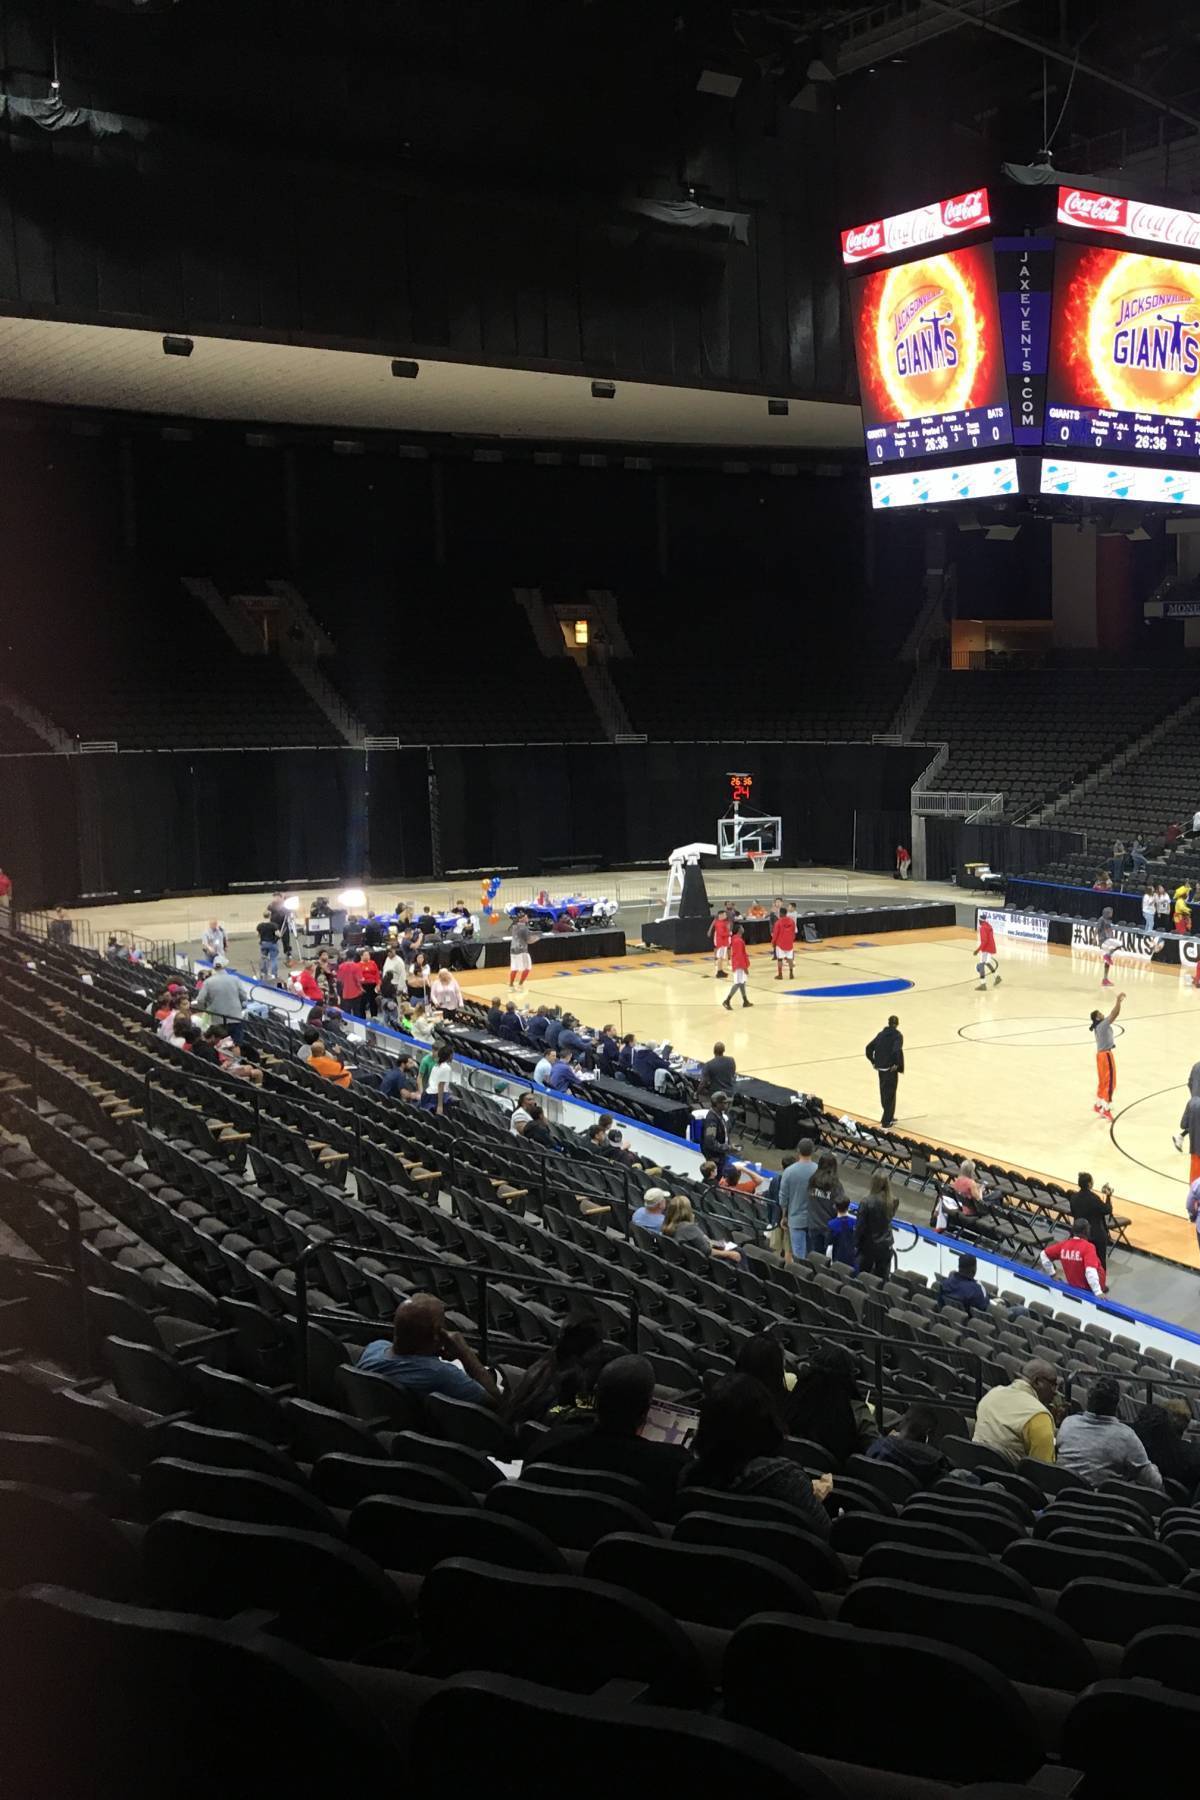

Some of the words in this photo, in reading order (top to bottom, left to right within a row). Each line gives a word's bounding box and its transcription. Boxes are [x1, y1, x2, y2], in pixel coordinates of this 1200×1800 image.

[1065, 191, 1122, 223] Coca-Cola
[895, 326, 958, 377] GIANTS
[1113, 327, 1200, 375] GIANTS
[987, 408, 1003, 419] BATS
[1049, 408, 1080, 420] GIANTS
[922, 427, 940, 437] Period
[992, 427, 999, 441] 0
[1061, 427, 1069, 440] 0
[1134, 423, 1159, 434] Period
[1095, 436, 1102, 447] 0
[1117, 431, 1122, 440] 3
[1134, 434, 1167, 450] 26:36
[1176, 438, 1182, 447] 3
[876, 445, 883, 458] 0
[733, 785, 750, 800] 24
